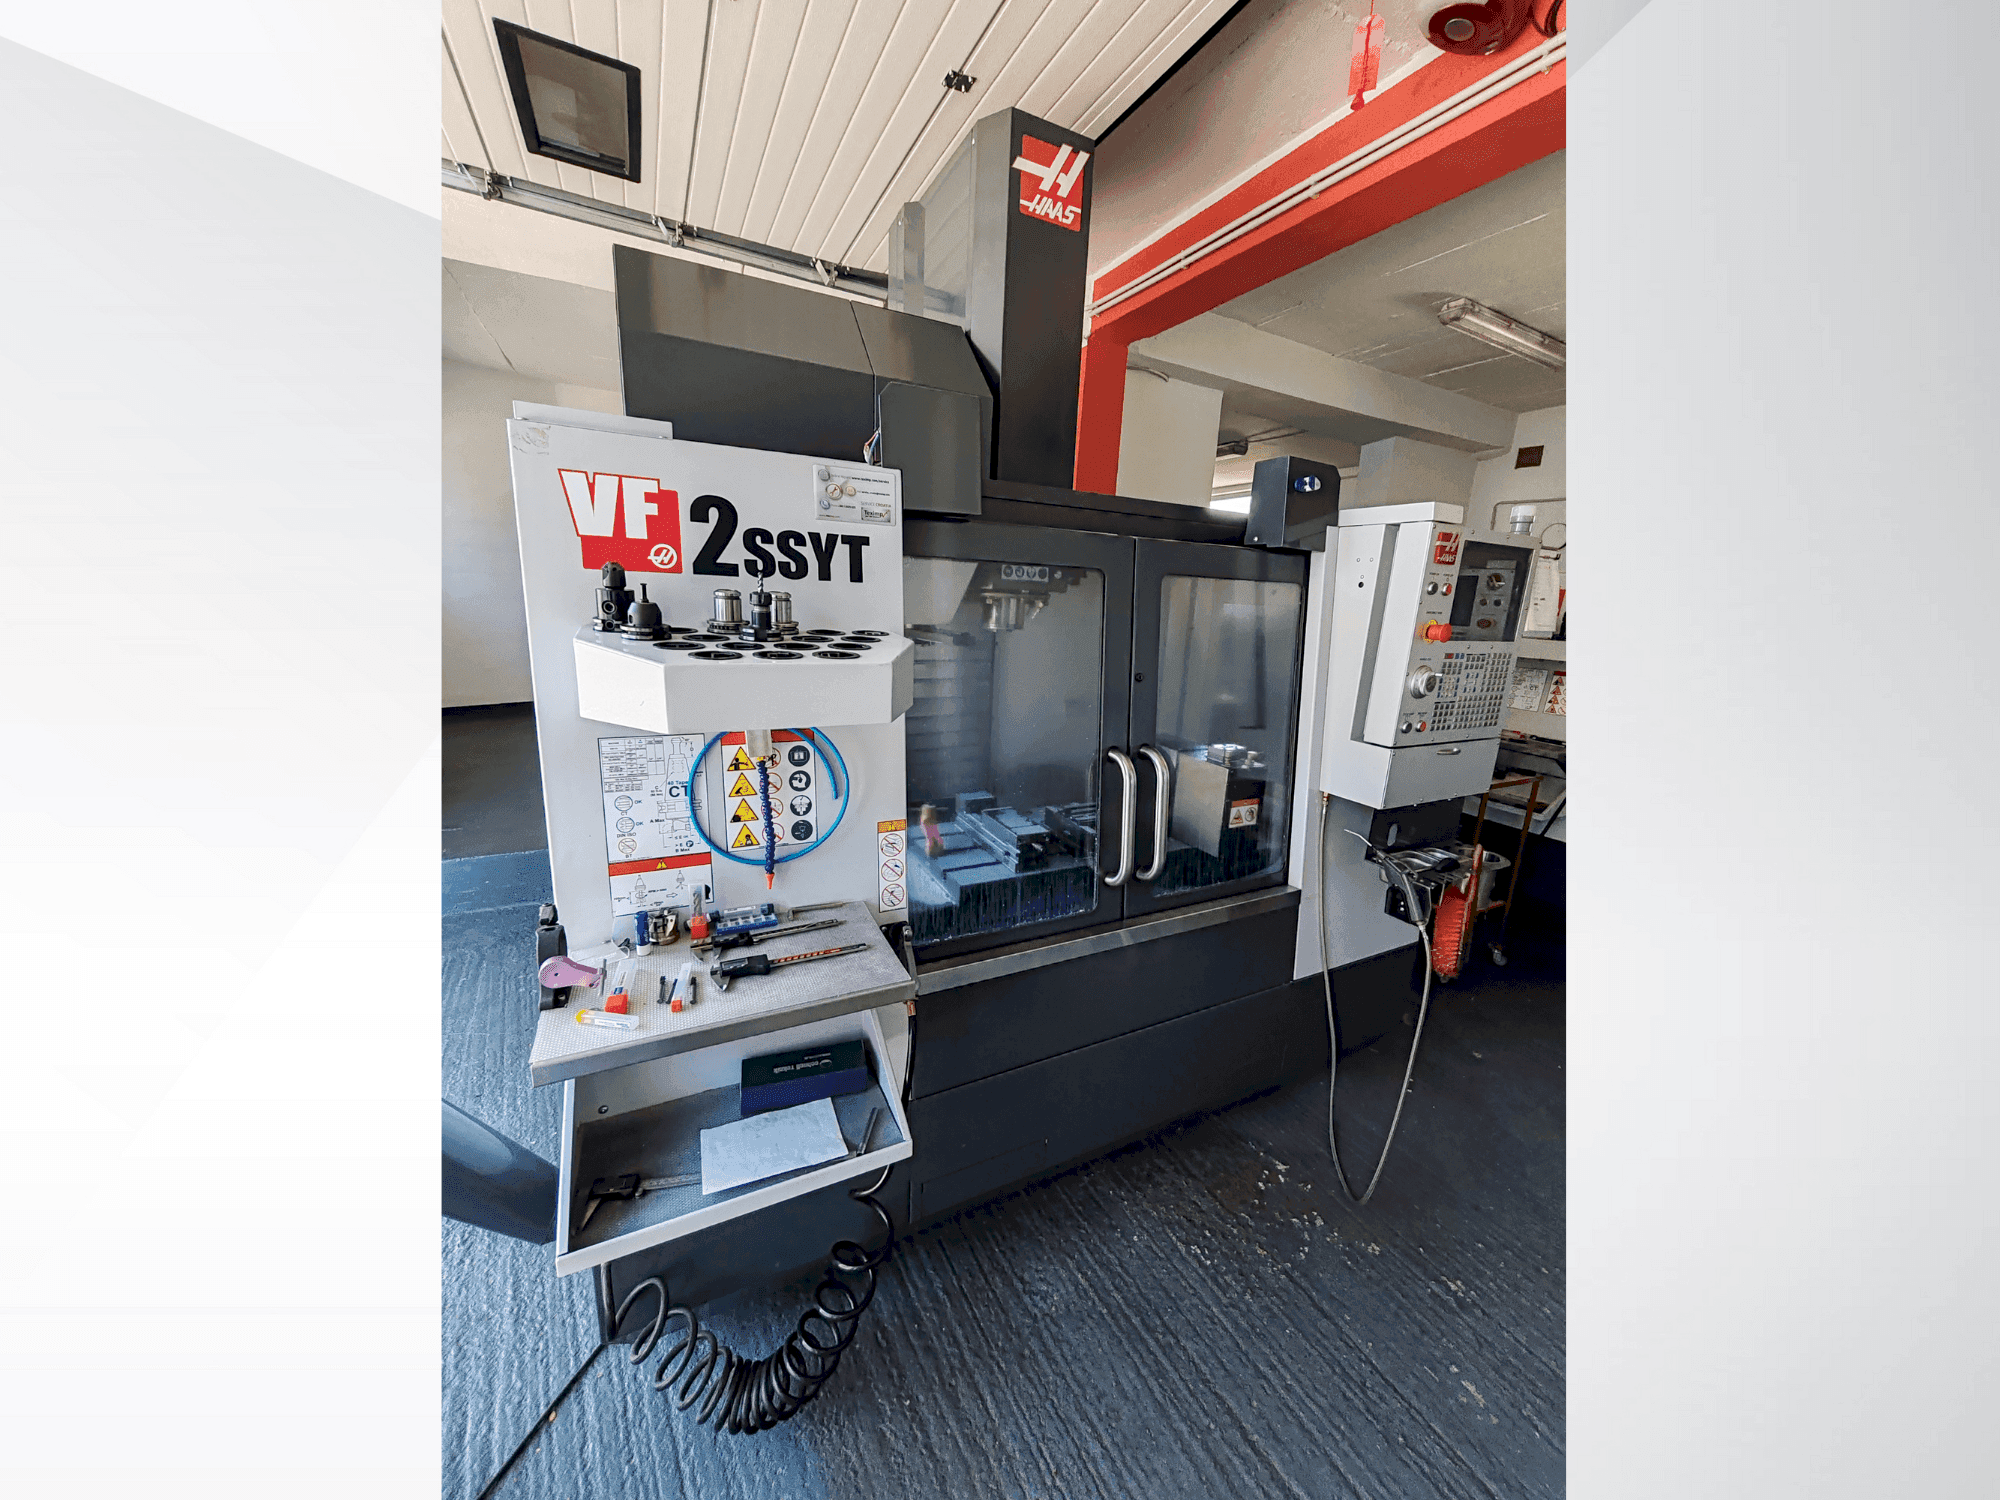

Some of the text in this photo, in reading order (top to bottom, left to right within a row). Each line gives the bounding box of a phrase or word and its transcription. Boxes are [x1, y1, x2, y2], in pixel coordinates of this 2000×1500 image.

[1020, 193, 1082, 225] HAAS
[558, 468, 660, 540] VF
[668, 785, 688, 798] CT
